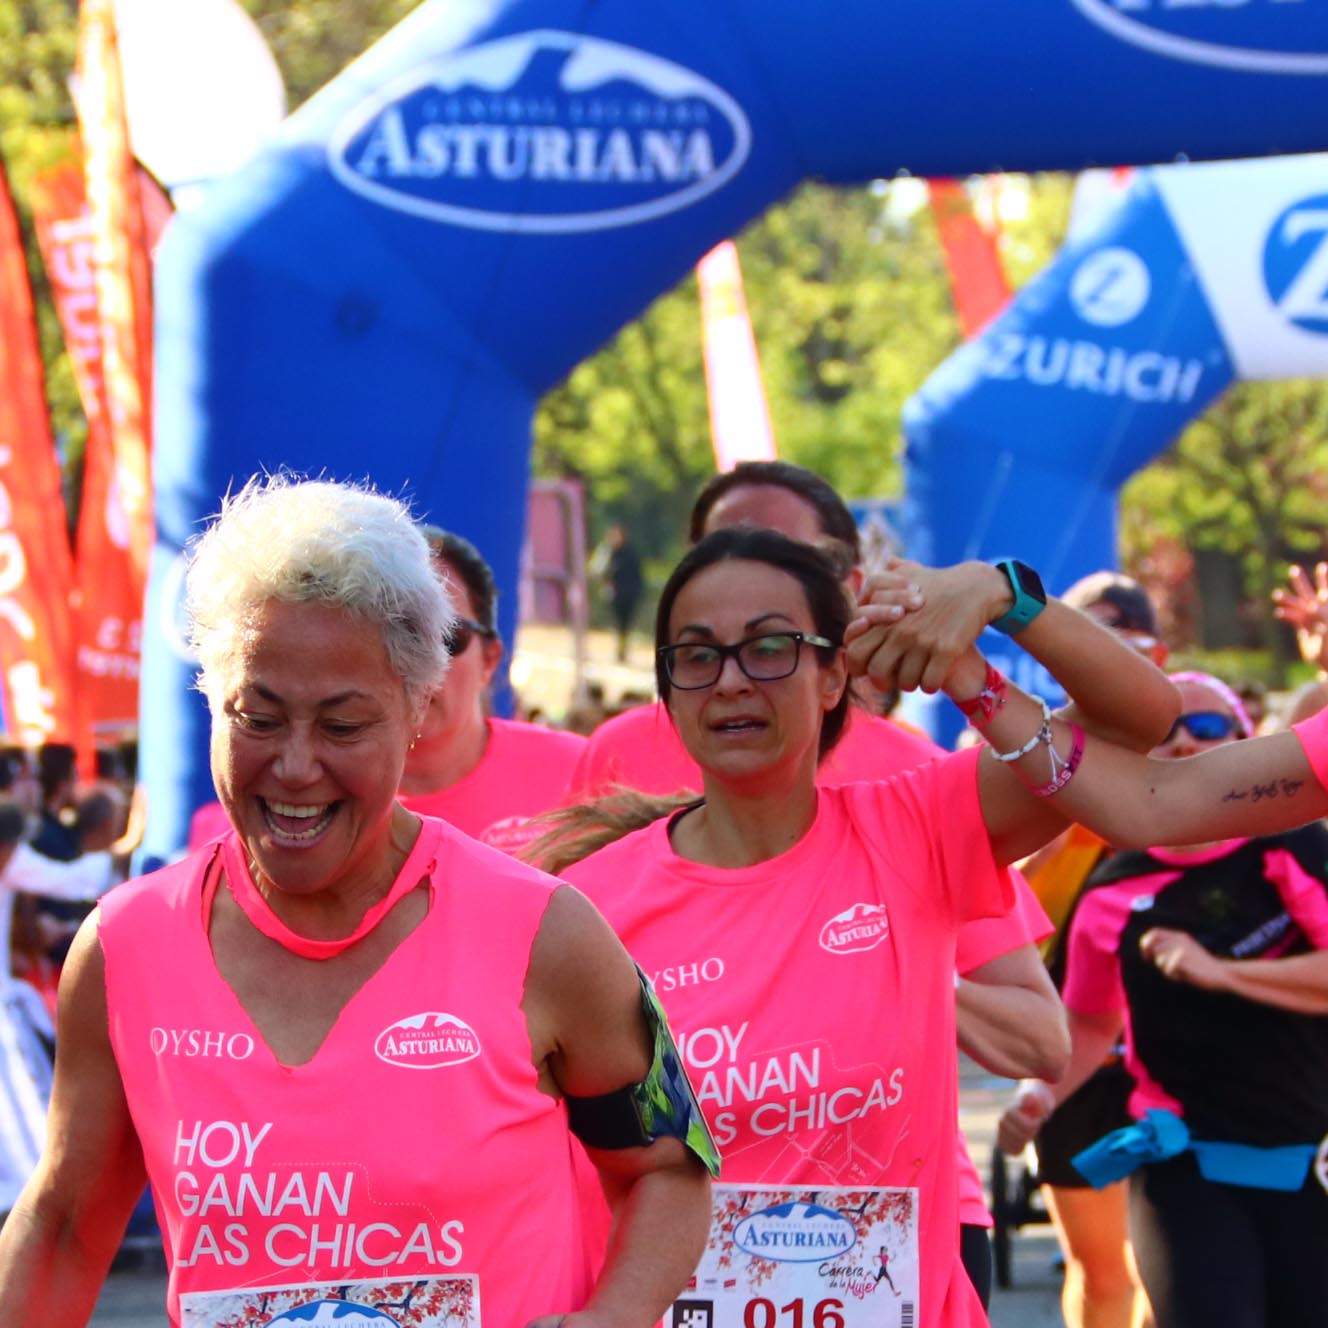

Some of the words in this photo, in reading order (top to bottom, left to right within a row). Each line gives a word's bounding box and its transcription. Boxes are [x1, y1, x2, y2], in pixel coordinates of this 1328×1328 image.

[358, 106, 714, 181] ASTURIANA
[981, 333, 1204, 403] ZURICH
[647, 957, 724, 993] YSHO
[150, 1027, 254, 1060] OYSHO
[383, 1034, 475, 1057] ASTURIANA
[697, 1049, 820, 1107] ANAN
[750, 1068, 903, 1136] CHICAS
[174, 1119, 273, 1168] HOY
[174, 1170, 354, 1217] GANAN
[265, 1220, 465, 1268] CHICAS
[744, 1225, 848, 1248] ASTURIANA
[818, 1262, 864, 1277] Carrera
